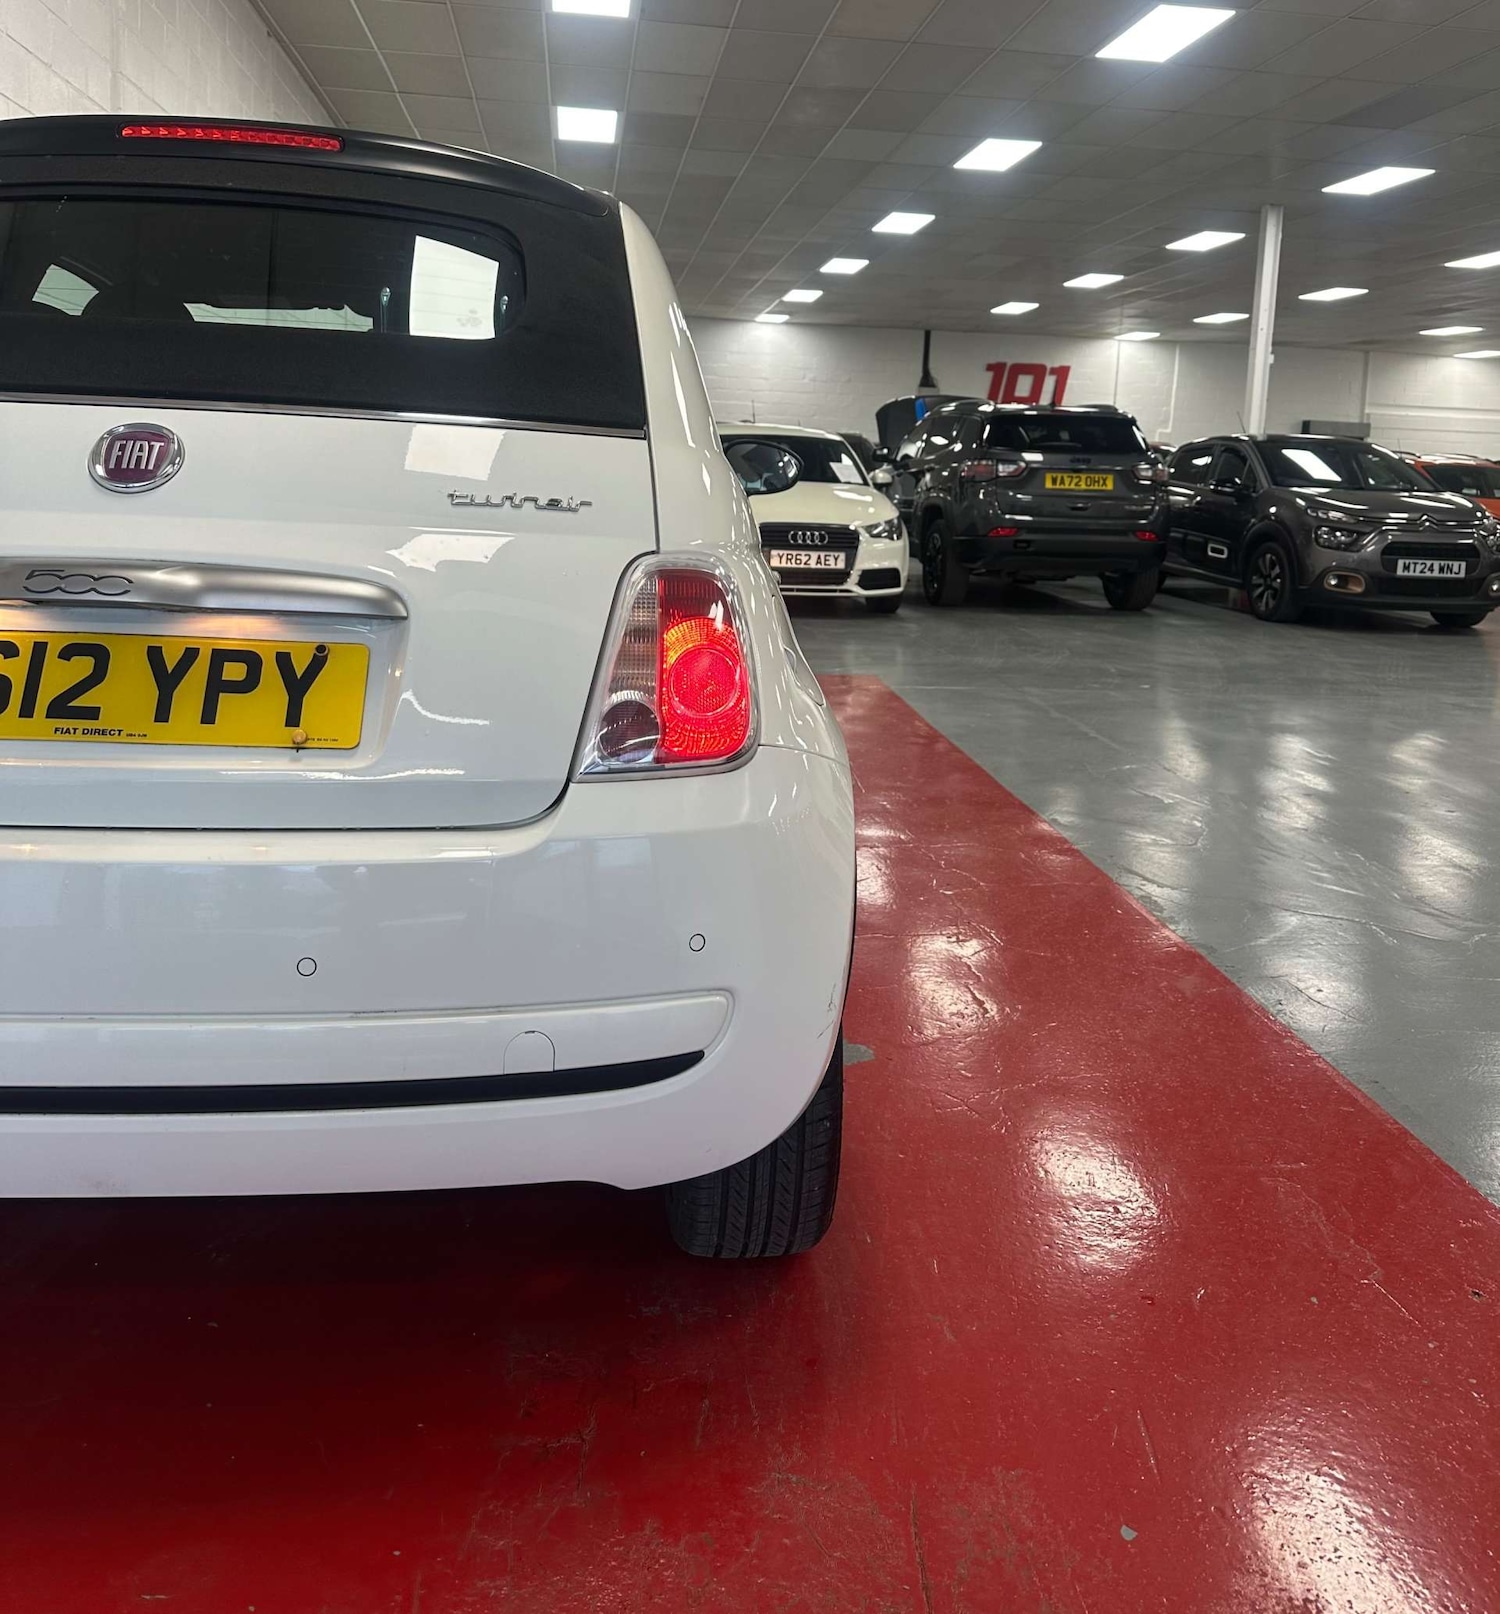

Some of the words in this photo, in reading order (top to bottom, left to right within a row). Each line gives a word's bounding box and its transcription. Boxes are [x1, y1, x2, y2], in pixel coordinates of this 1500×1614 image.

[985, 361, 1071, 406] 101
[108, 440, 165, 470] FIAT
[1051, 474, 1083, 488] WA72
[447, 489, 593, 513] twinair
[777, 552, 812, 567] YR62
[815, 554, 840, 567] AEY
[1402, 561, 1435, 575] MT24
[1438, 562, 1462, 576] WNJ
[23, 569, 134, 596] 500
[0, 640, 112, 721] 12
[146, 645, 329, 728] YPY
[54, 727, 79, 735] FIAT
[81, 728, 124, 737] DIRECT
